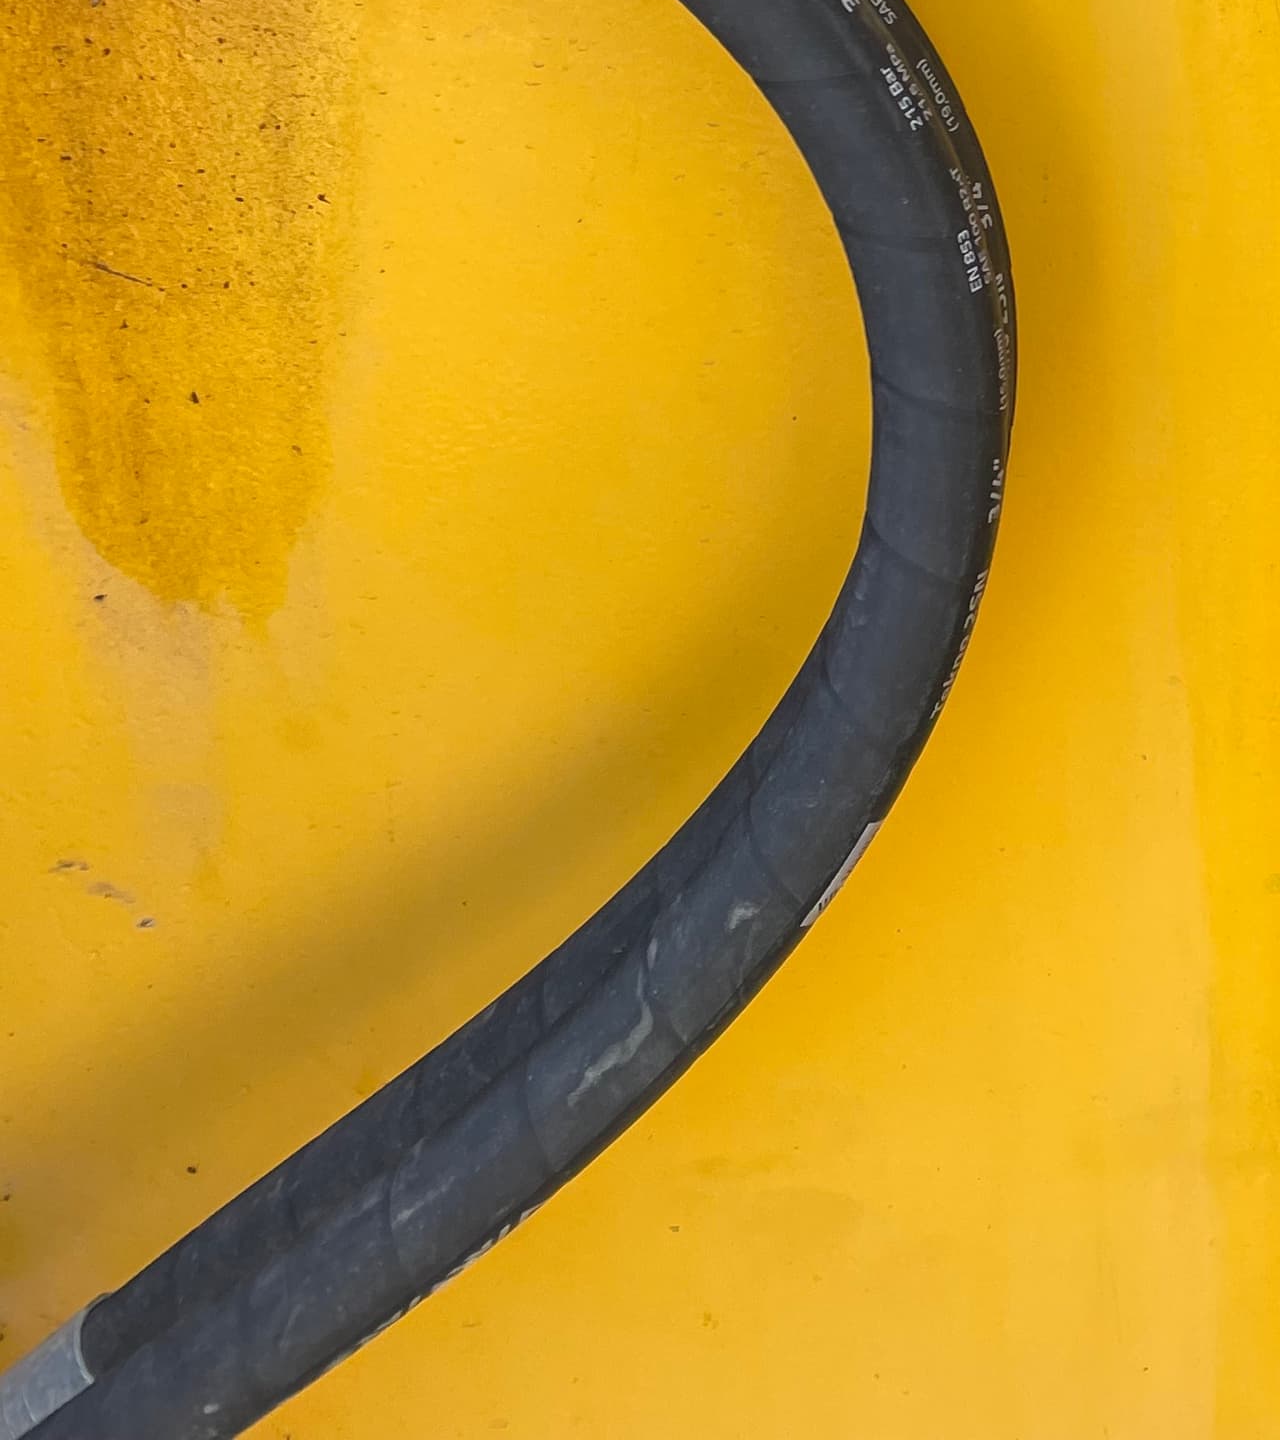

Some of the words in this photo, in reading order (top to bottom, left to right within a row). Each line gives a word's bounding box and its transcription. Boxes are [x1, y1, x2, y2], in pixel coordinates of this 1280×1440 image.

[880, 67, 904, 97] Bar
[916, 58, 960, 133] (19,0mm)
[897, 96, 924, 131] 215
[957, 229, 976, 265] 853
[966, 265, 983, 293] EN
